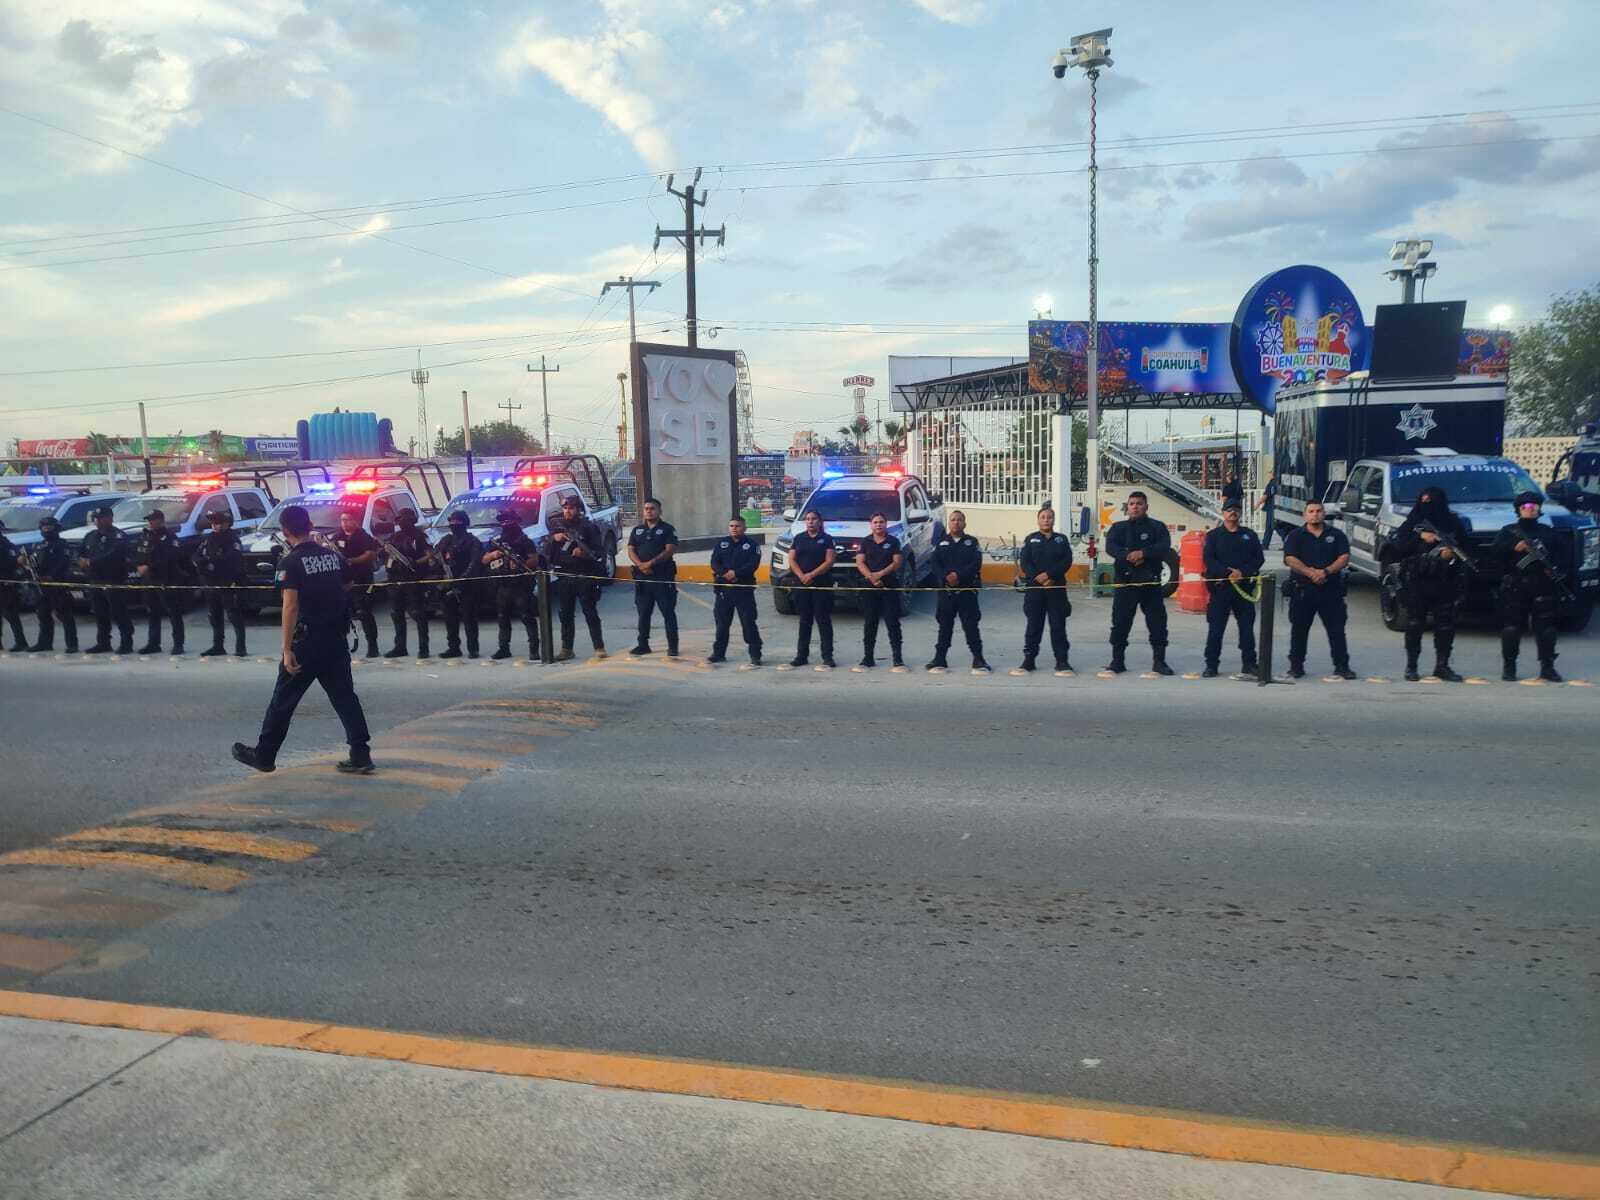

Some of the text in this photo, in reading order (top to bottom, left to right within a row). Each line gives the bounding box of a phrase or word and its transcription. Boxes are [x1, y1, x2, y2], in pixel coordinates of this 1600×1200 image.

[642, 356, 695, 403] YO
[1149, 359, 1200, 371] COAHUILA
[1261, 353, 1350, 373] BUENAVENTURA
[661, 409, 722, 457] SB
